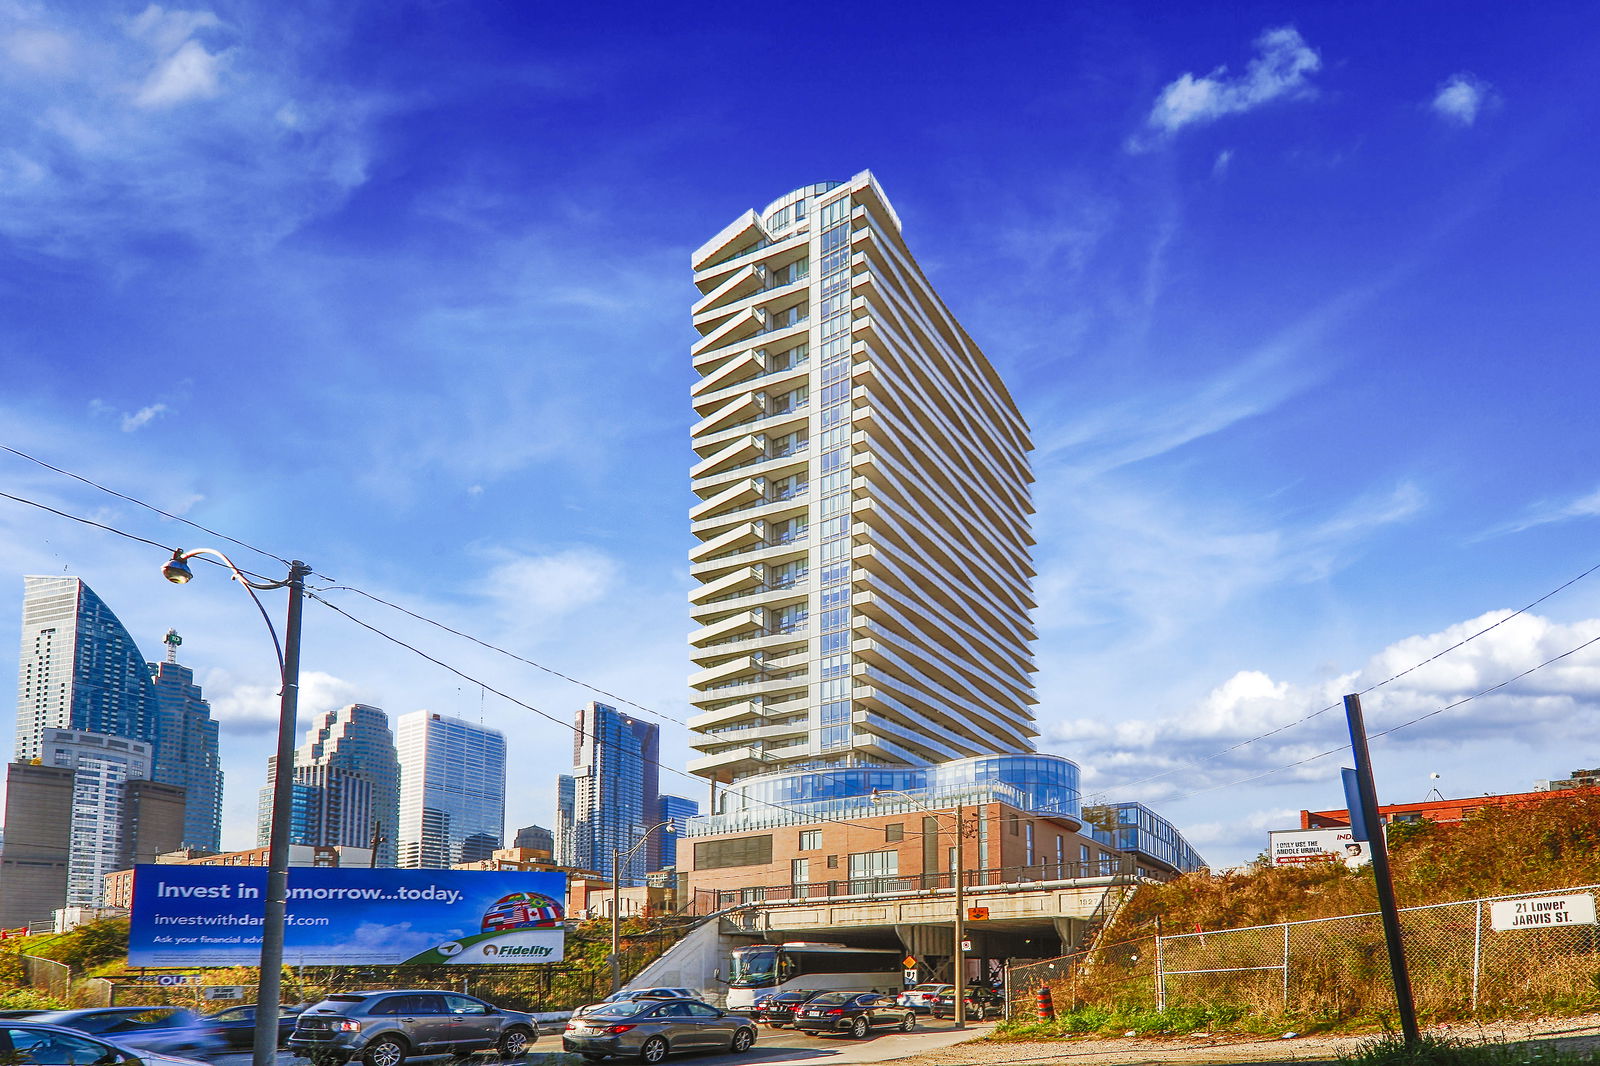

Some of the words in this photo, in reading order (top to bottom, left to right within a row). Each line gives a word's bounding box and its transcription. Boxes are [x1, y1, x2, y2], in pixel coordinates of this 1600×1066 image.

[157, 882, 231, 898] Invest
[238, 883, 258, 899] in
[285, 885, 464, 904] morrow...today.
[1515, 903, 1527, 914] 21
[1531, 900, 1565, 912] Lower
[1512, 913, 1551, 926] JARVIS
[1555, 911, 1572, 923] ST.
[153, 935, 173, 943] Ask
[175, 936, 198, 945] your
[200, 935, 241, 944] financial
[499, 946, 553, 957] Fidelity
